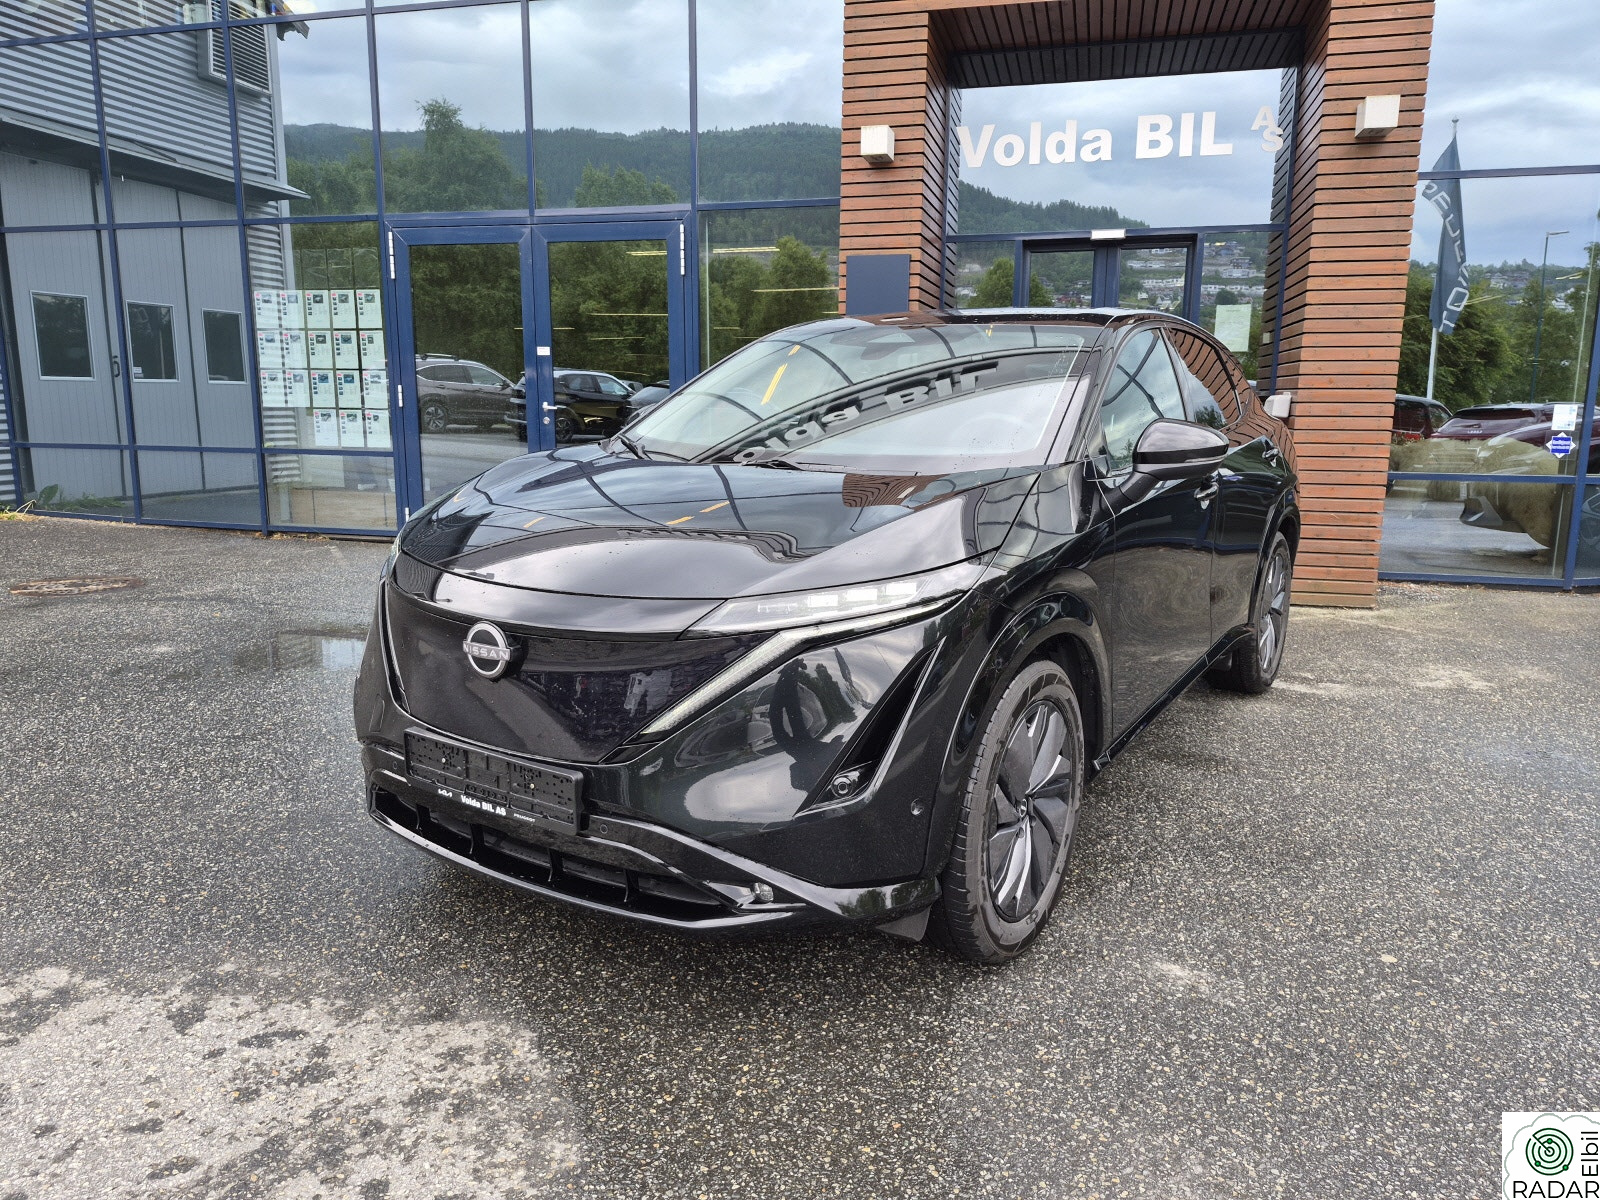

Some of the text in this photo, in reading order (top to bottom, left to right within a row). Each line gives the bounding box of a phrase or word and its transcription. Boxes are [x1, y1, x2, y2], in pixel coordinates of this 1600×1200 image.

[956, 119, 1112, 168] Volda
[1135, 111, 1233, 159] BIL
[463, 641, 510, 661] NISSAN
[461, 795, 480, 808] Volda
[495, 806, 507, 816] AS
